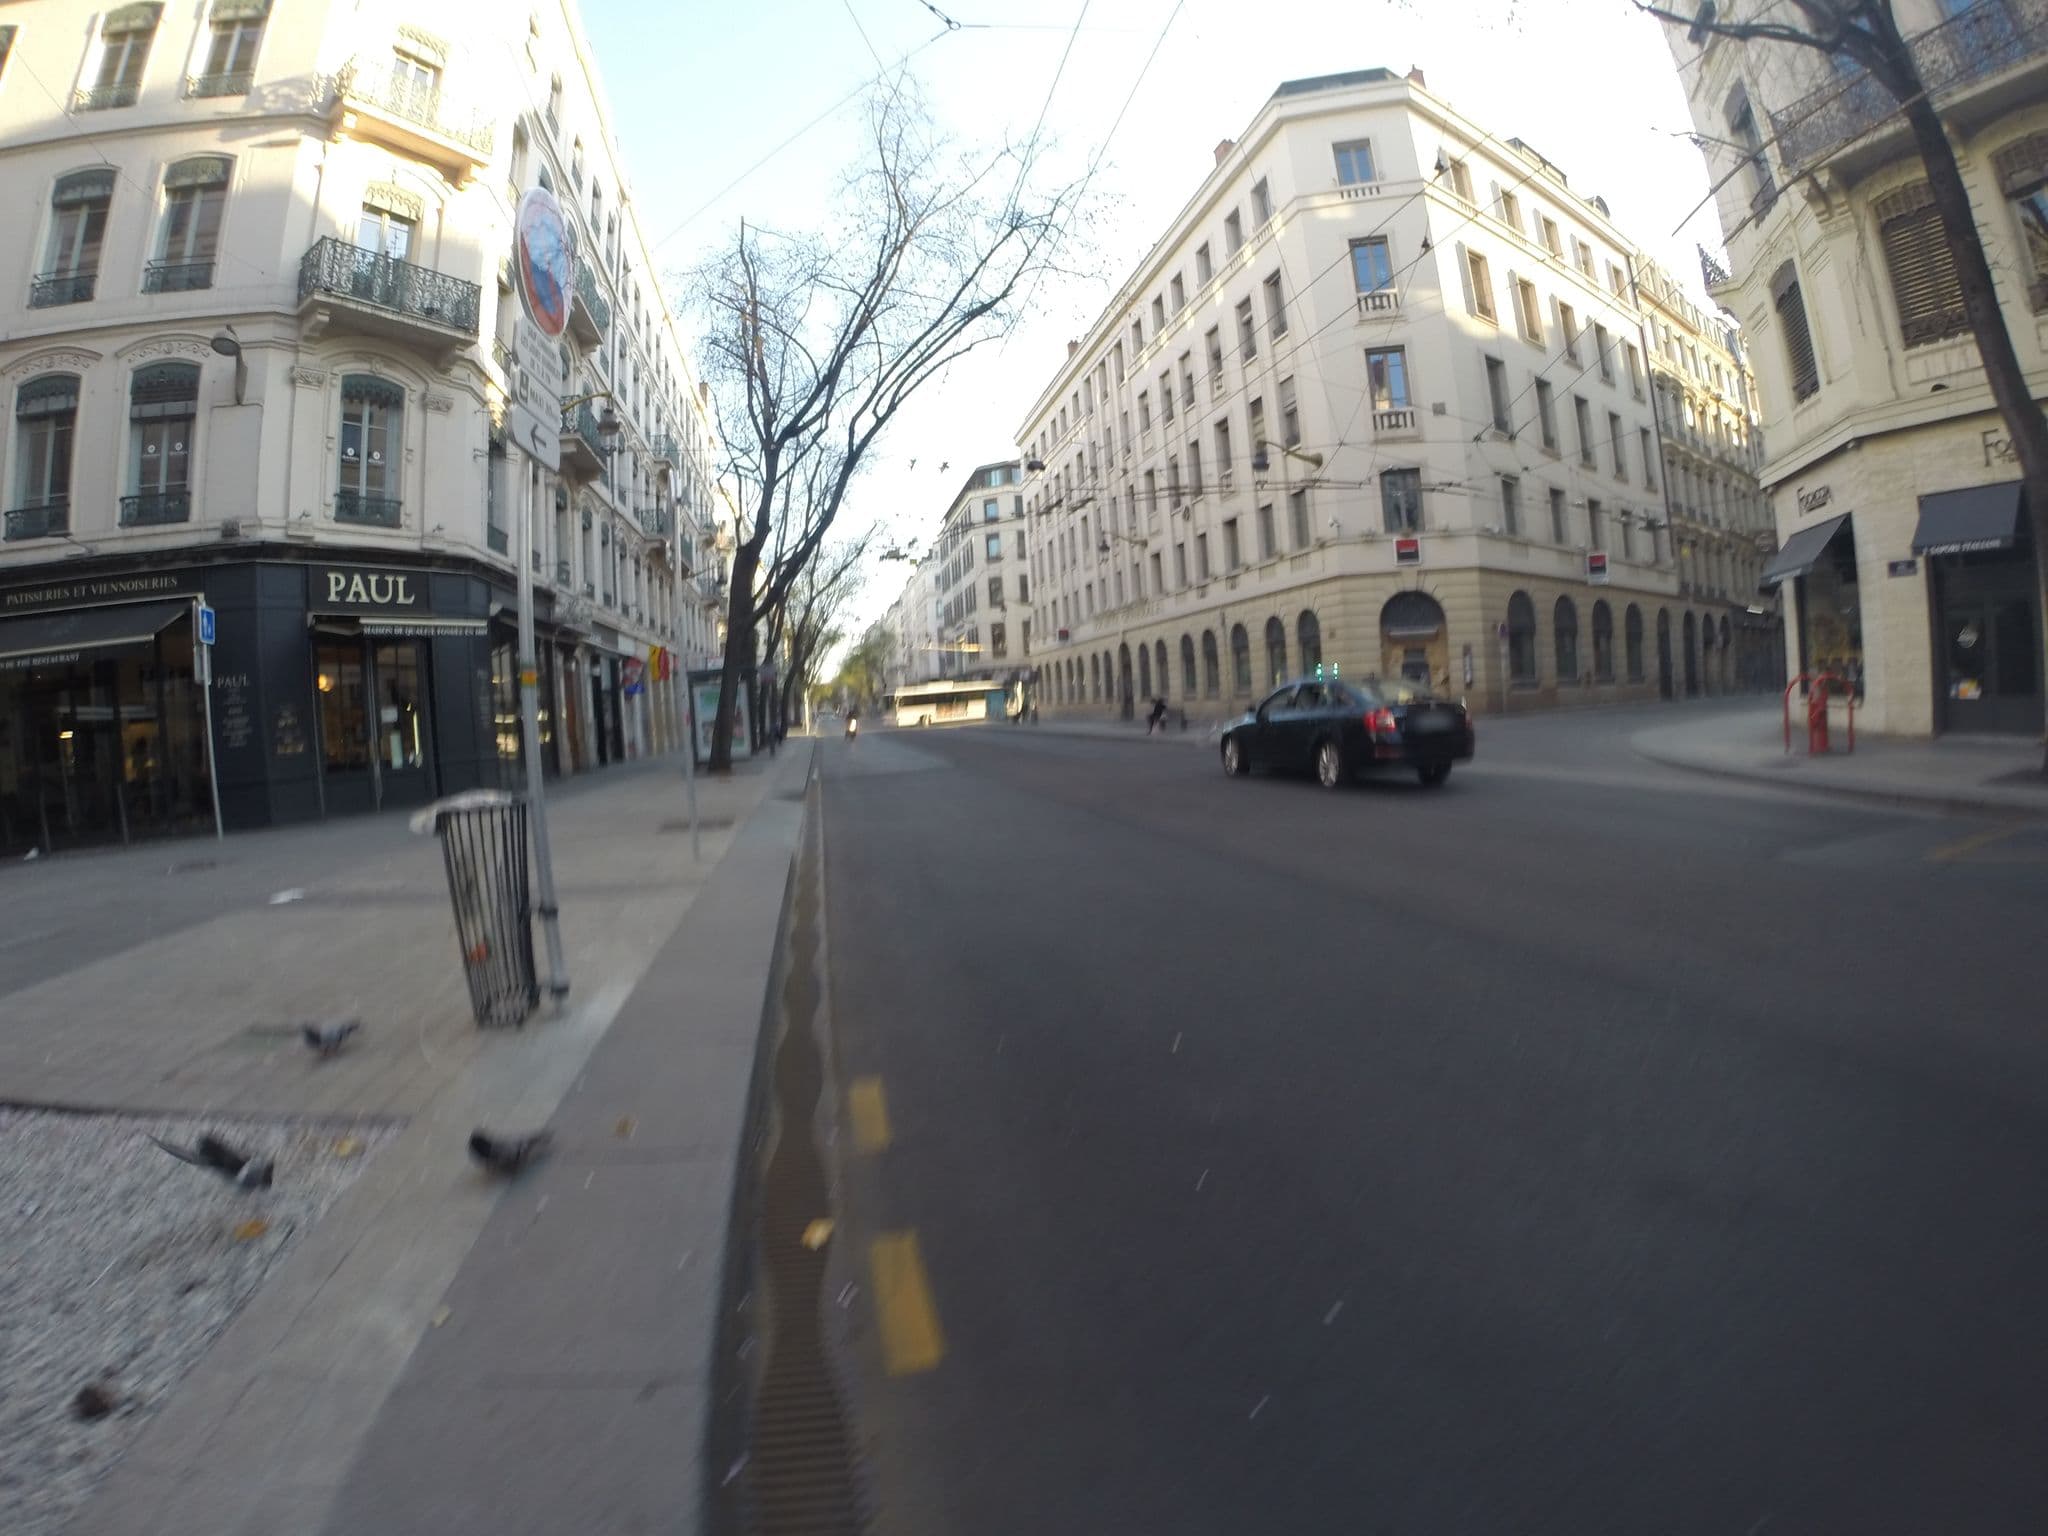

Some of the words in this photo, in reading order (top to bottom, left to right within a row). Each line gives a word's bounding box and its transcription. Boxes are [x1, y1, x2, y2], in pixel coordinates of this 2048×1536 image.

[73, 585, 87, 598] ET
[90, 575, 178, 595] VIENNOISERIES
[327, 571, 415, 604] PAUL
[217, 672, 249, 689] PAUL
